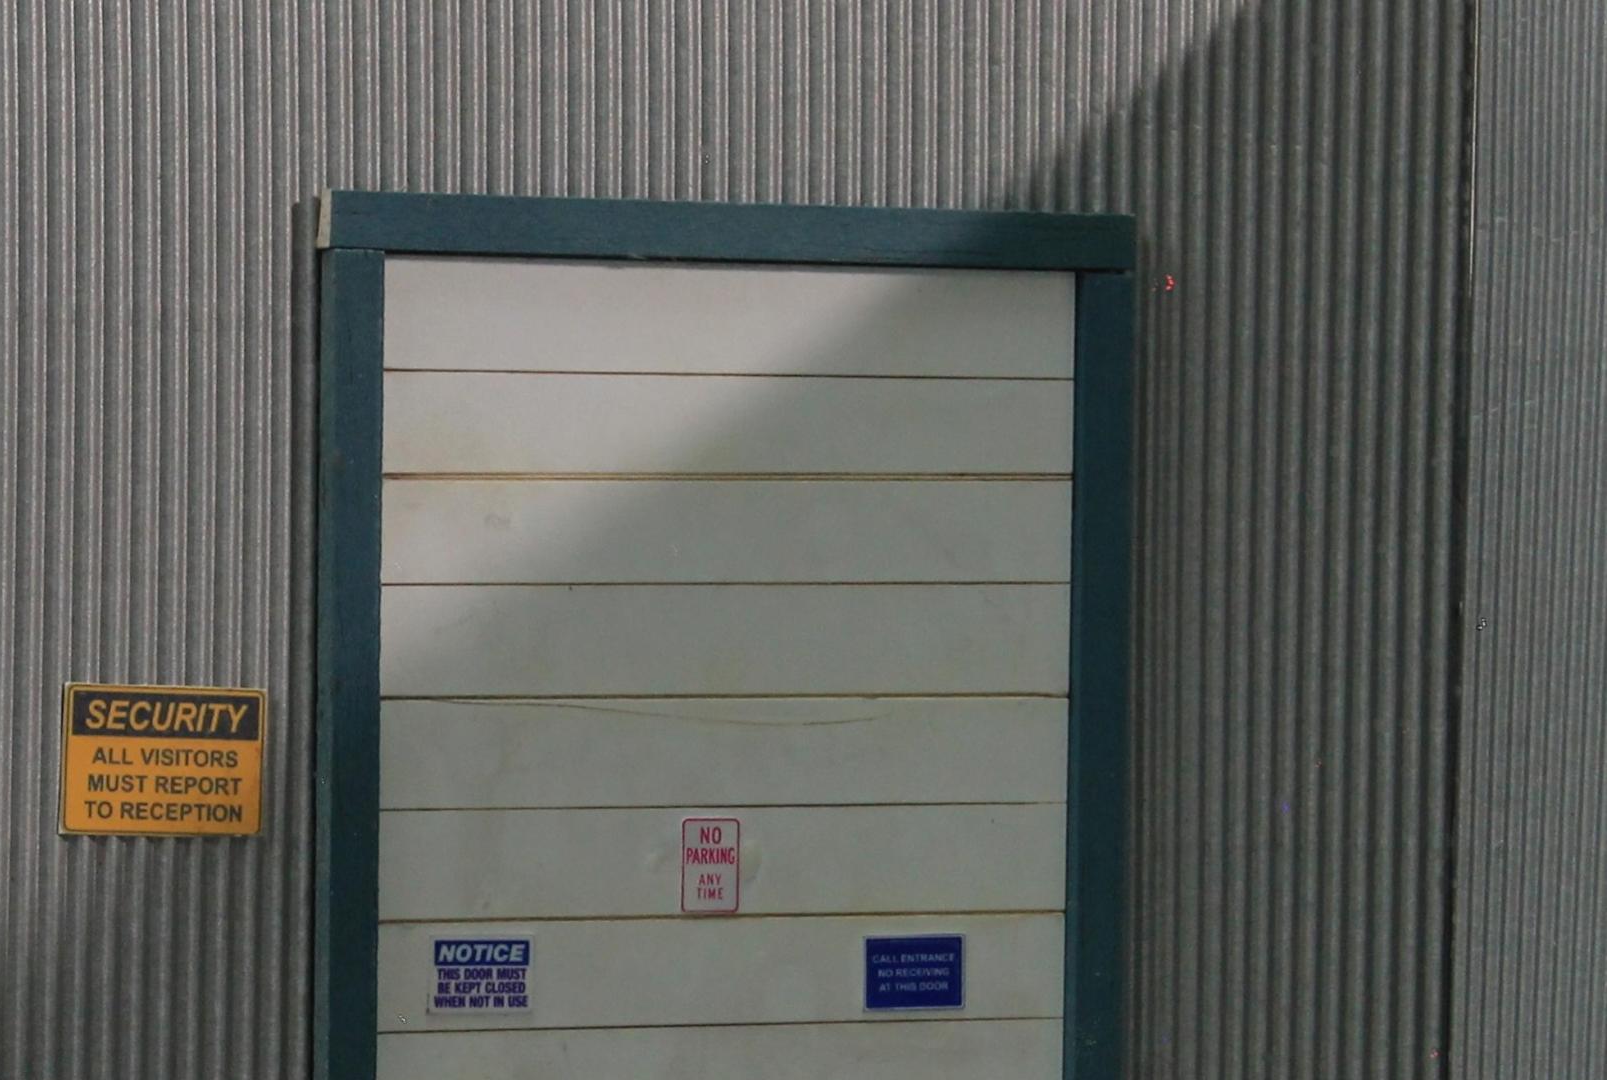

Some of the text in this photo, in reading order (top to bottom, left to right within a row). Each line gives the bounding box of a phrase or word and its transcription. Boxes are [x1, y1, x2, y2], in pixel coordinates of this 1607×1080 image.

[85, 699, 248, 733] SECURITY
[92, 747, 238, 768] ALL VISITORS
[87, 774, 242, 796] MUST REPORT
[85, 801, 243, 823] TO RECEPTION
[700, 826, 722, 844] NO
[686, 847, 735, 865] PARKING
[698, 873, 722, 886] ANY
[697, 887, 723, 900] TIME
[438, 944, 525, 962] NOTICE
[872, 953, 955, 964] CALL ENTRANCE
[437, 968, 527, 980] THIS DOOR MUST
[877, 968, 893, 977] NO
[437, 982, 526, 994] BE KEPT CLOSED
[879, 982, 891, 992] AT
[895, 982, 917, 992] THIS
[434, 995, 528, 1008] WHEN NOT IN USE
